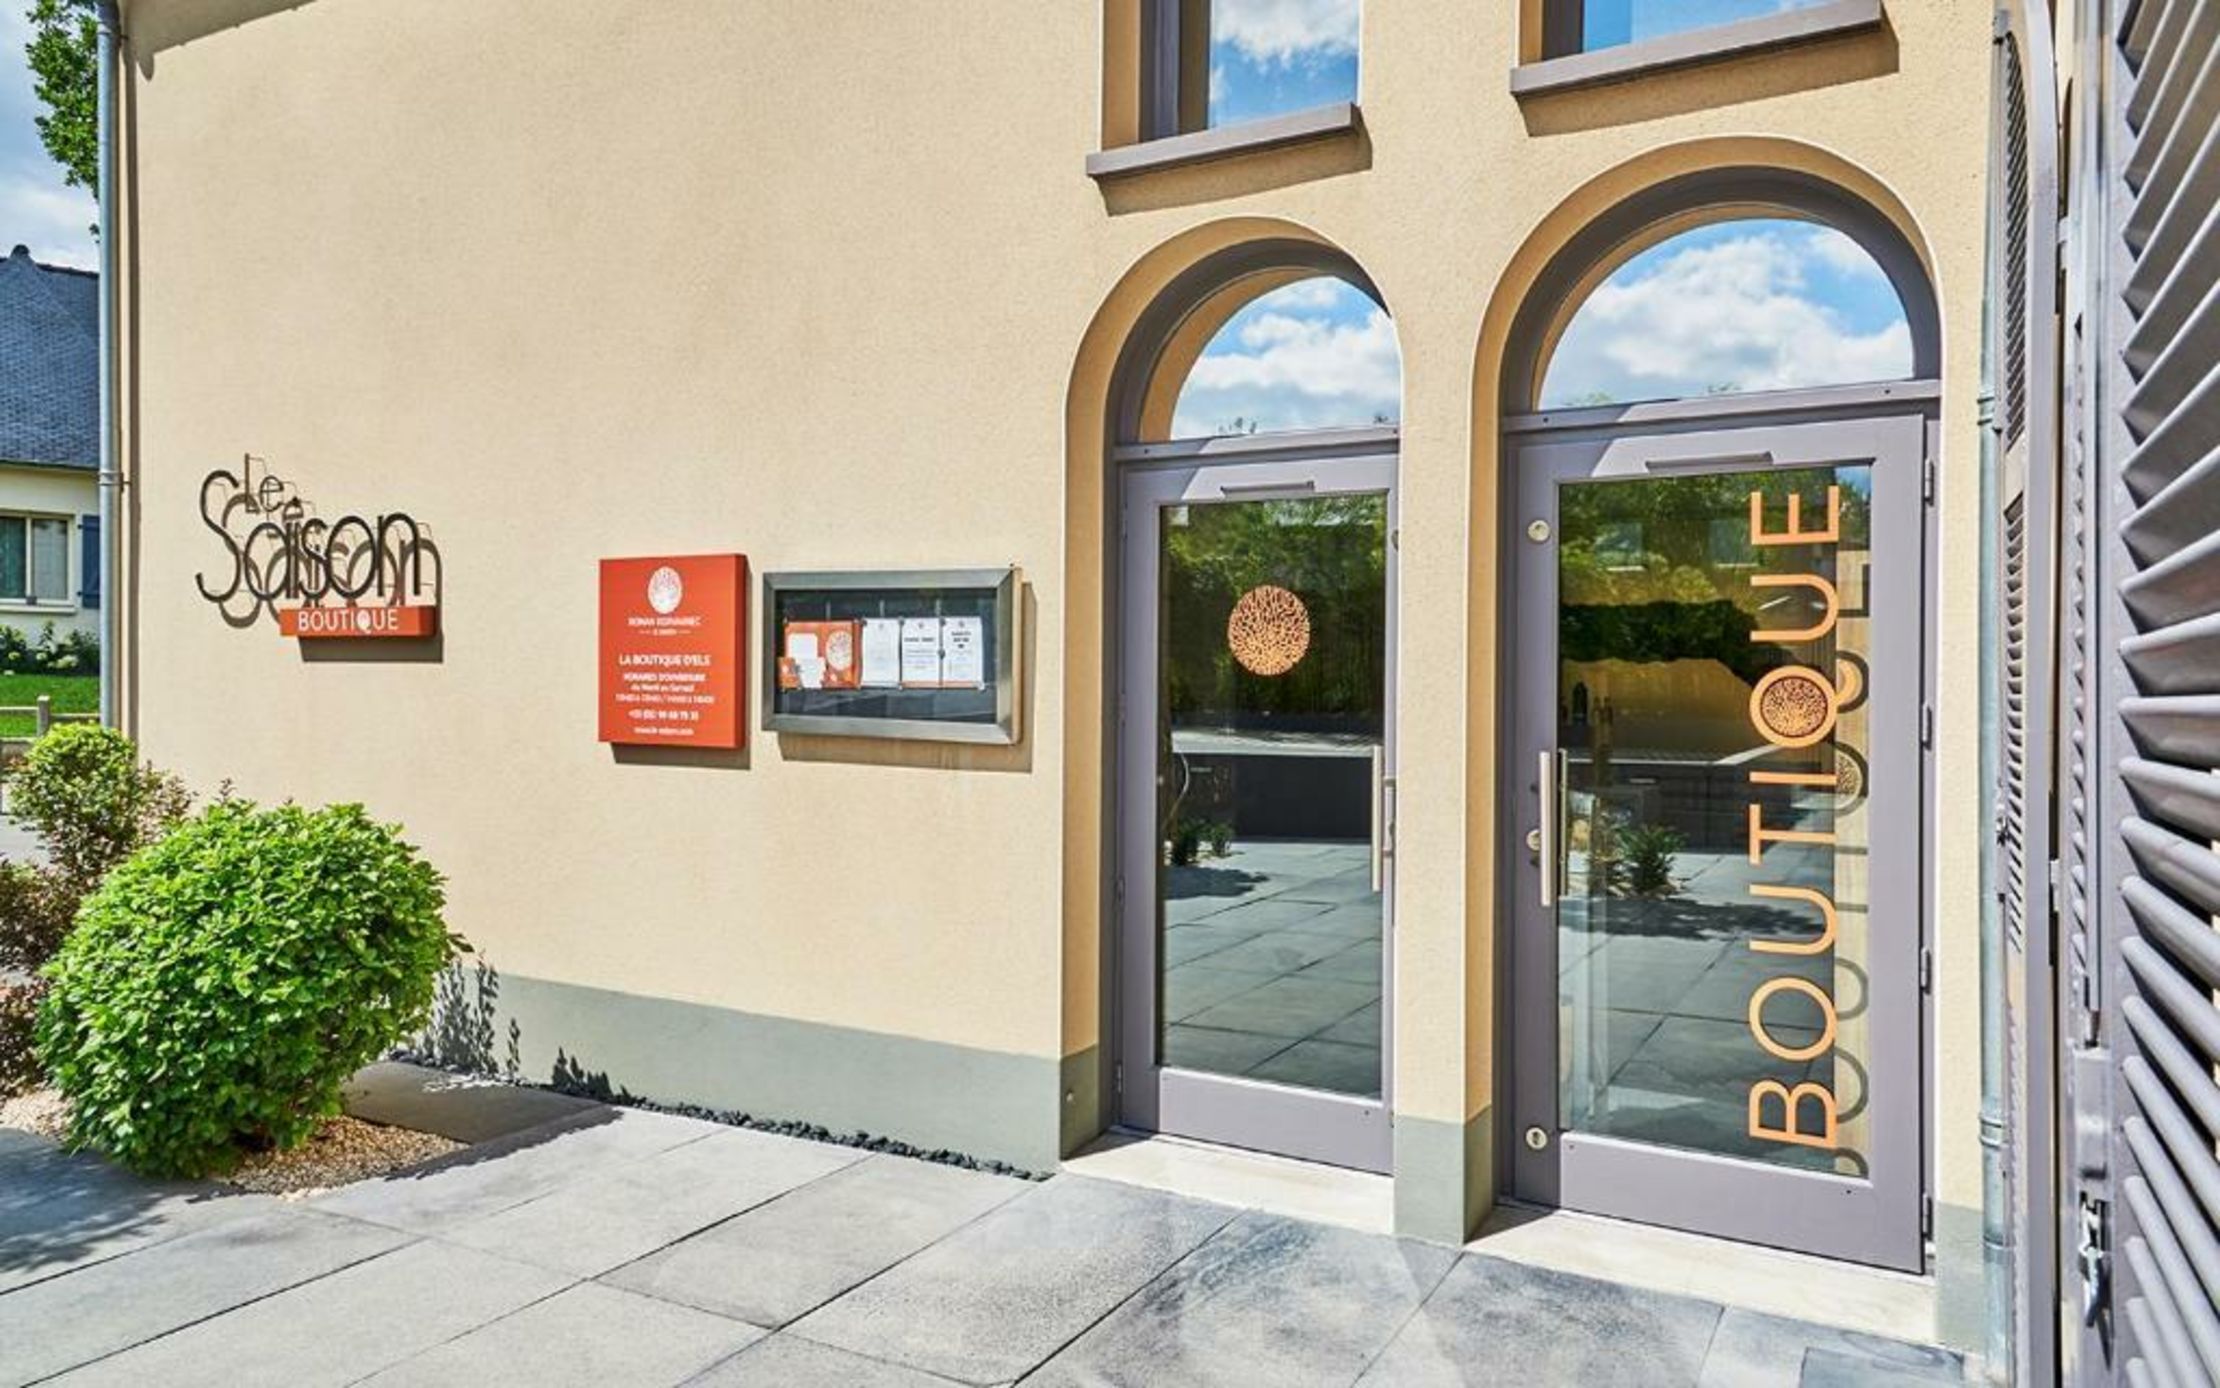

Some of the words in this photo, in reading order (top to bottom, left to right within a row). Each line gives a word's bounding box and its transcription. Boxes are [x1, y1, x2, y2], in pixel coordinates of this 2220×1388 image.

[245, 453, 284, 513] Le
[195, 470, 421, 603] Saison
[297, 608, 400, 634] BOUTIQUE
[618, 653, 632, 667] LA
[632, 653, 681, 669] BOUTIQUE
[1748, 484, 1840, 1149] BOUTIQUE
